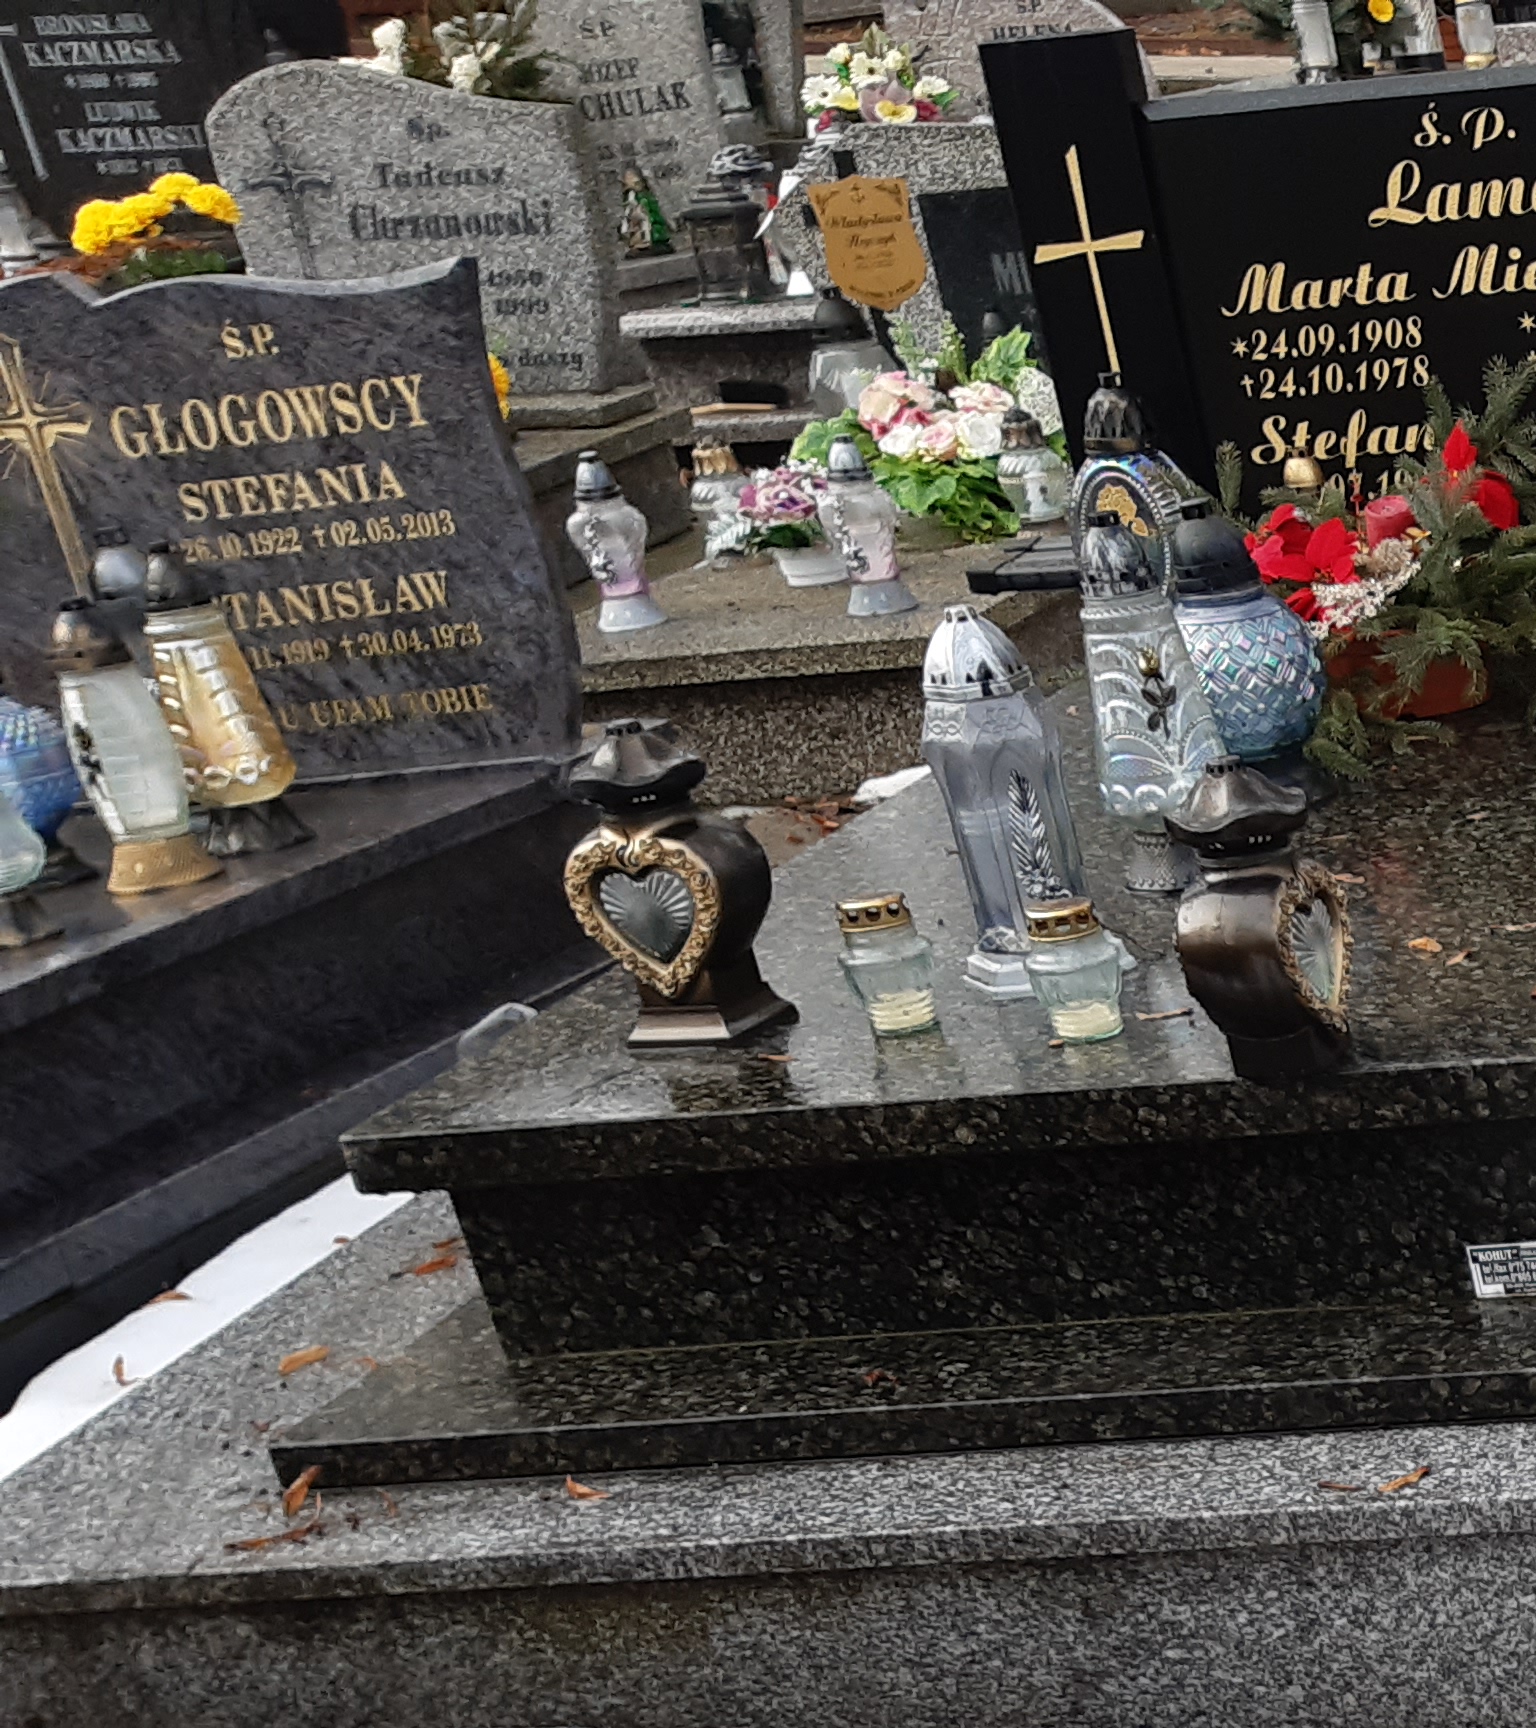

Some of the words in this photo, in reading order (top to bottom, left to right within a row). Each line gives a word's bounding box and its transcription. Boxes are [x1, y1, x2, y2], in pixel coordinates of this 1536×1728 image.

[1221, 262, 1416, 317] Marta
[1251, 316, 1423, 362] 24.09.1908
[1258, 354, 1431, 400] 24.10.1978
[1251, 408, 1436, 468] Stefan
[178, 460, 406, 523] STEFANIA
[330, 509, 456, 547] 02.05.2013
[211, 570, 449, 631] TANISŁAW
[404, 683, 494, 718] TOBIE
